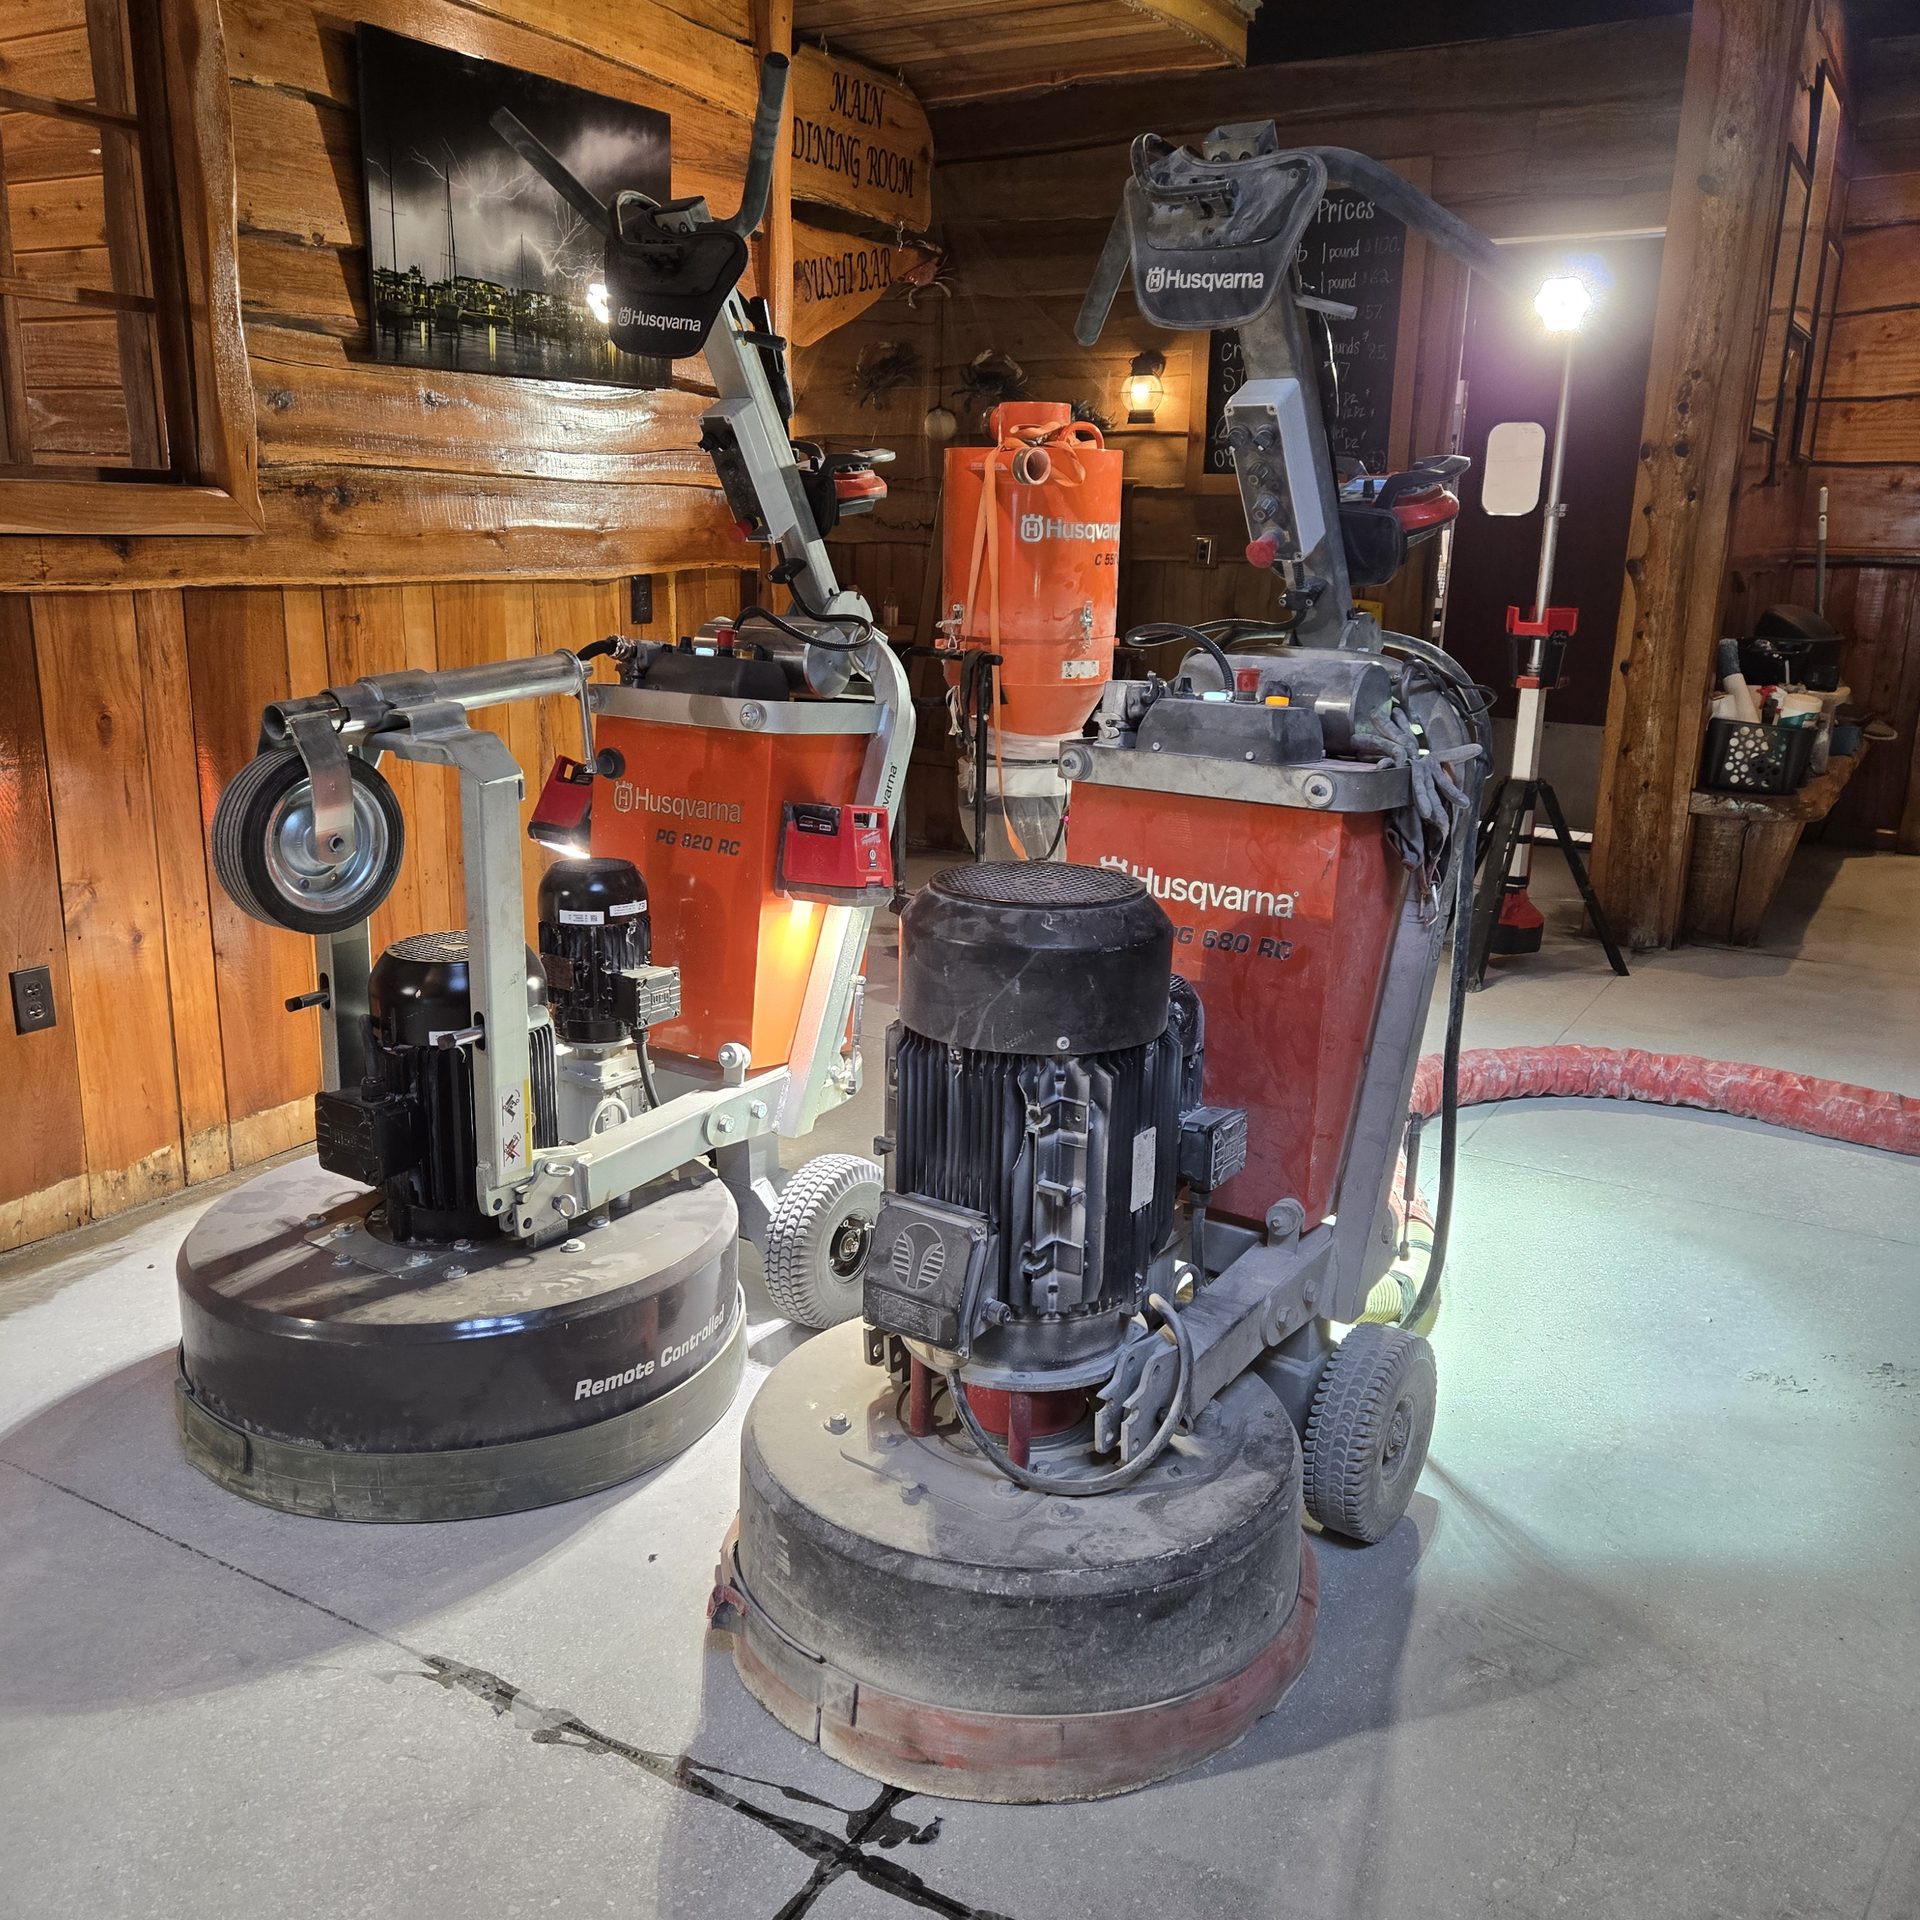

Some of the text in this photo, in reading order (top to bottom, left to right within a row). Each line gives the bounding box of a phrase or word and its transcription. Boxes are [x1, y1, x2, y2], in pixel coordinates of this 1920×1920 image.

[830, 71, 886, 129] MAIN
[792, 116, 914, 198] DINING ROOM
[1317, 198, 1376, 223] Prices
[1329, 239, 1360, 262] pound
[803, 247, 893, 302] SUSHI BAR
[1166, 269, 1264, 292] Husqvarna
[1327, 271, 1357, 295] pound
[631, 310, 702, 332] Husqvarna
[882, 765, 898, 806] varna
[635, 787, 742, 823] Husqvarna
[655, 828, 741, 856] PG 820 RC
[1132, 864, 1295, 919] Husqvarna
[1202, 929, 1251, 955] 680
[1257, 937, 1294, 961] RC
[574, 1303, 725, 1401] Remote Controlled
